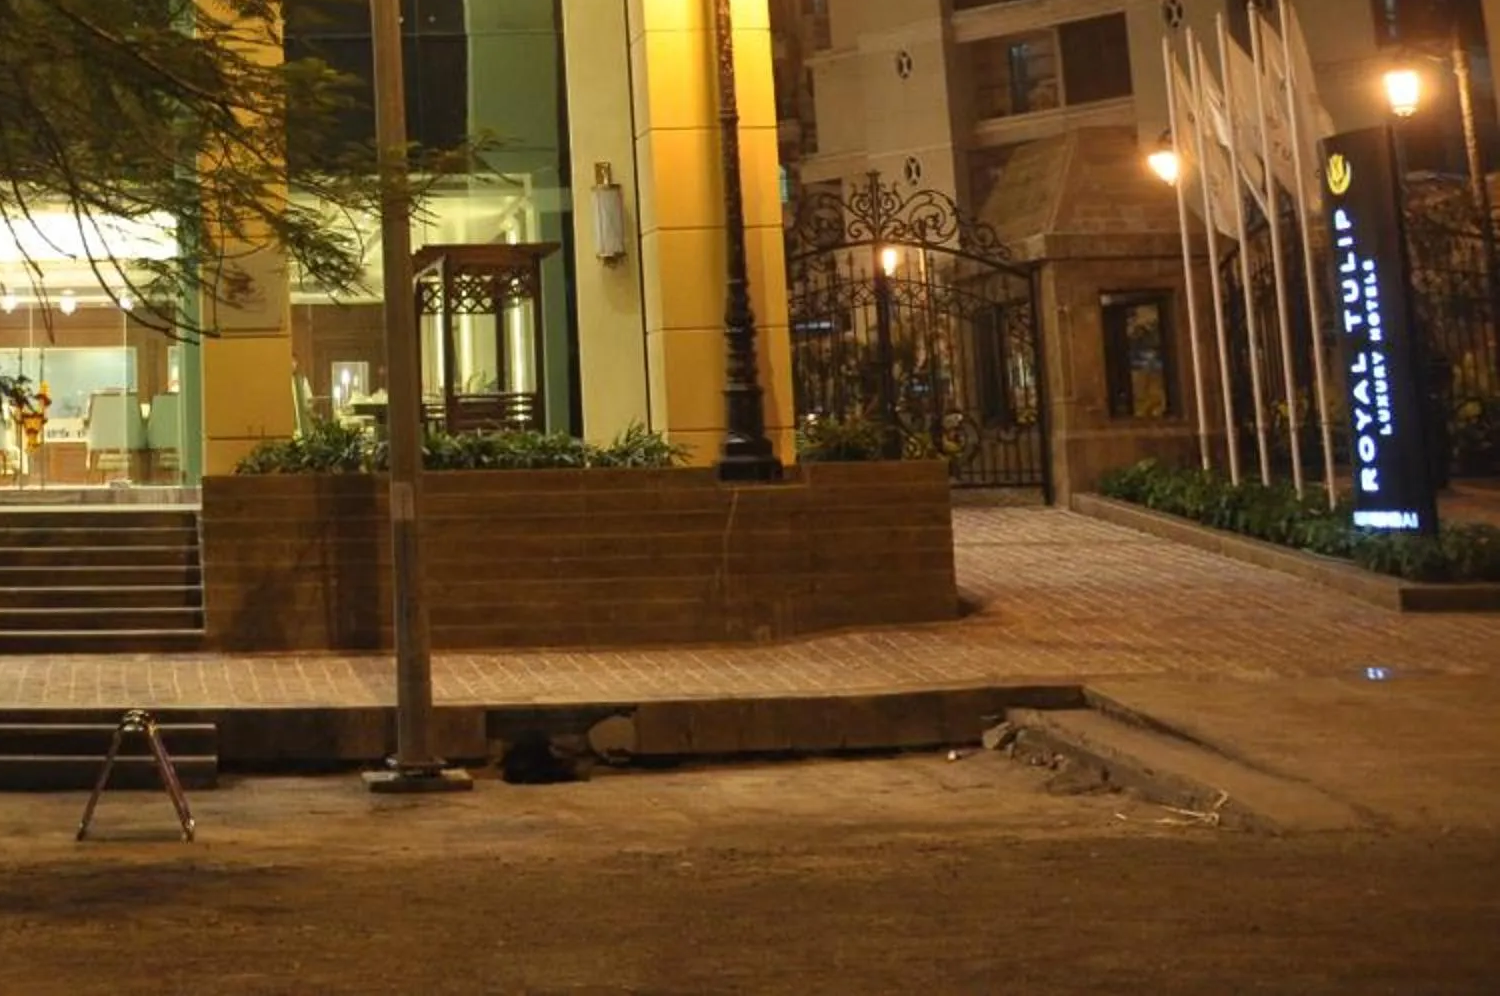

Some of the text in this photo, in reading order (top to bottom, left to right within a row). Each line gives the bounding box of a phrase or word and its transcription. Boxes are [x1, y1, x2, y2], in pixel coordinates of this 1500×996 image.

[1334, 208, 1380, 493] ROYAL TULIP
[1362, 259, 1393, 435] LUXURY HOTELS
